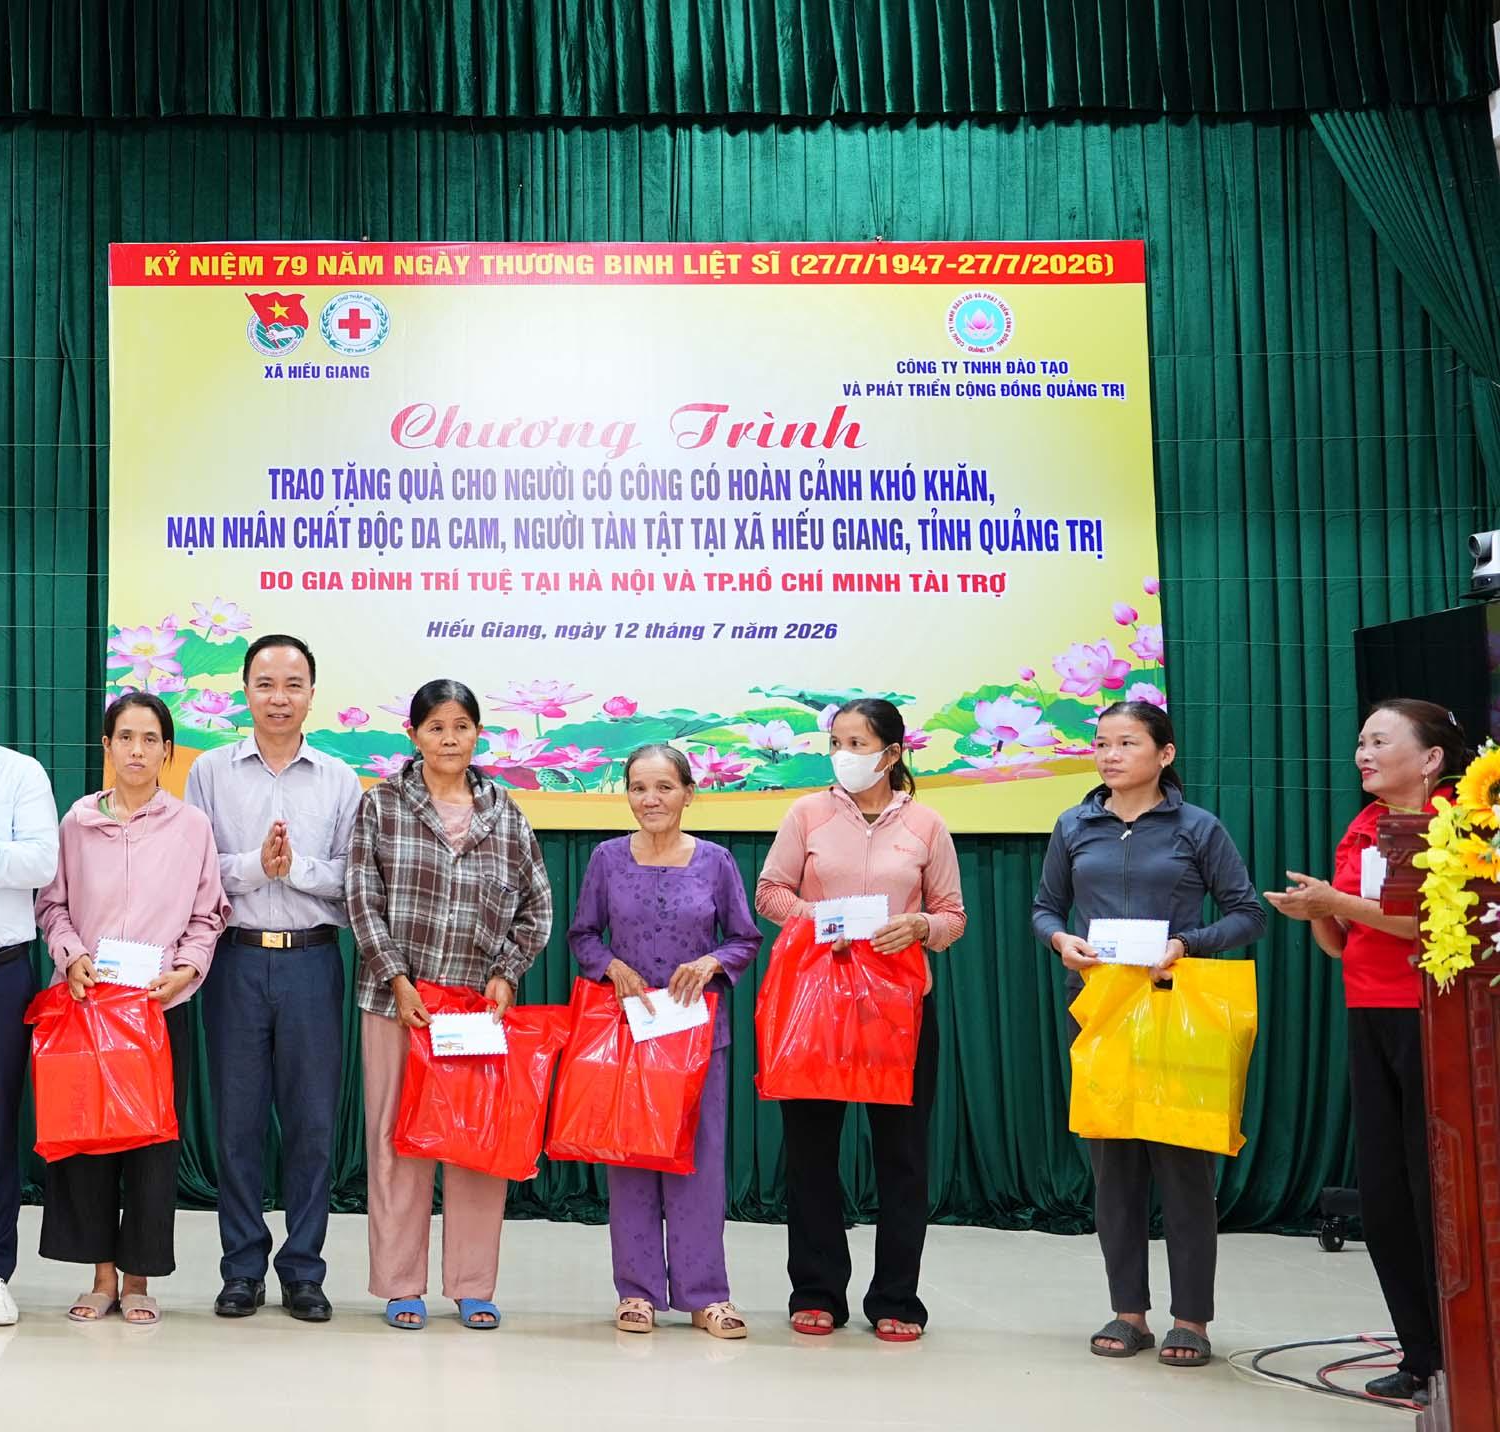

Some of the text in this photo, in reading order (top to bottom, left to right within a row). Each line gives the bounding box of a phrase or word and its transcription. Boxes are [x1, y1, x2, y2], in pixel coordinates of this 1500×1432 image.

[144, 249, 1114, 280] KỶ NIỆM 79 NĂM NGÀY THƯƠNG BINH LIỆT SĨ (27/7/1947-27/7/2026)
[264, 361, 370, 379] XÃ HIẾU GIANG
[896, 358, 1069, 378] CÔNG TY TNHH ĐÀO TẠO
[842, 378, 1125, 400] VÀ PHÁT TRIỂN CỘNG ĐỒNG QUẢNG TRỊ
[390, 402, 868, 460] Chương Trình
[267, 457, 995, 508] TRAO TẶNG QUÀ CHO NGƯỜI CÓ CÔNG CÓ HOÀN CẢNH KHÓ KHĂN,
[167, 502, 1103, 560] NẠN NHÂN CHẤT ĐỘC DA CAM, NGƯỜI TÀN TẬT TẠI XÃ HIẾU GIANG, TỈNH QUẢNG TRỊ
[260, 566, 1007, 598] DO GIA ĐÌNH TRÍ TUỆ TẠI HÀ NỘI VÀ TP.HỒ CHÍ MINH TÀI TRỢ
[426, 618, 838, 641] Hiếu Giang, ngày 12 tháng 7 năm 2026
